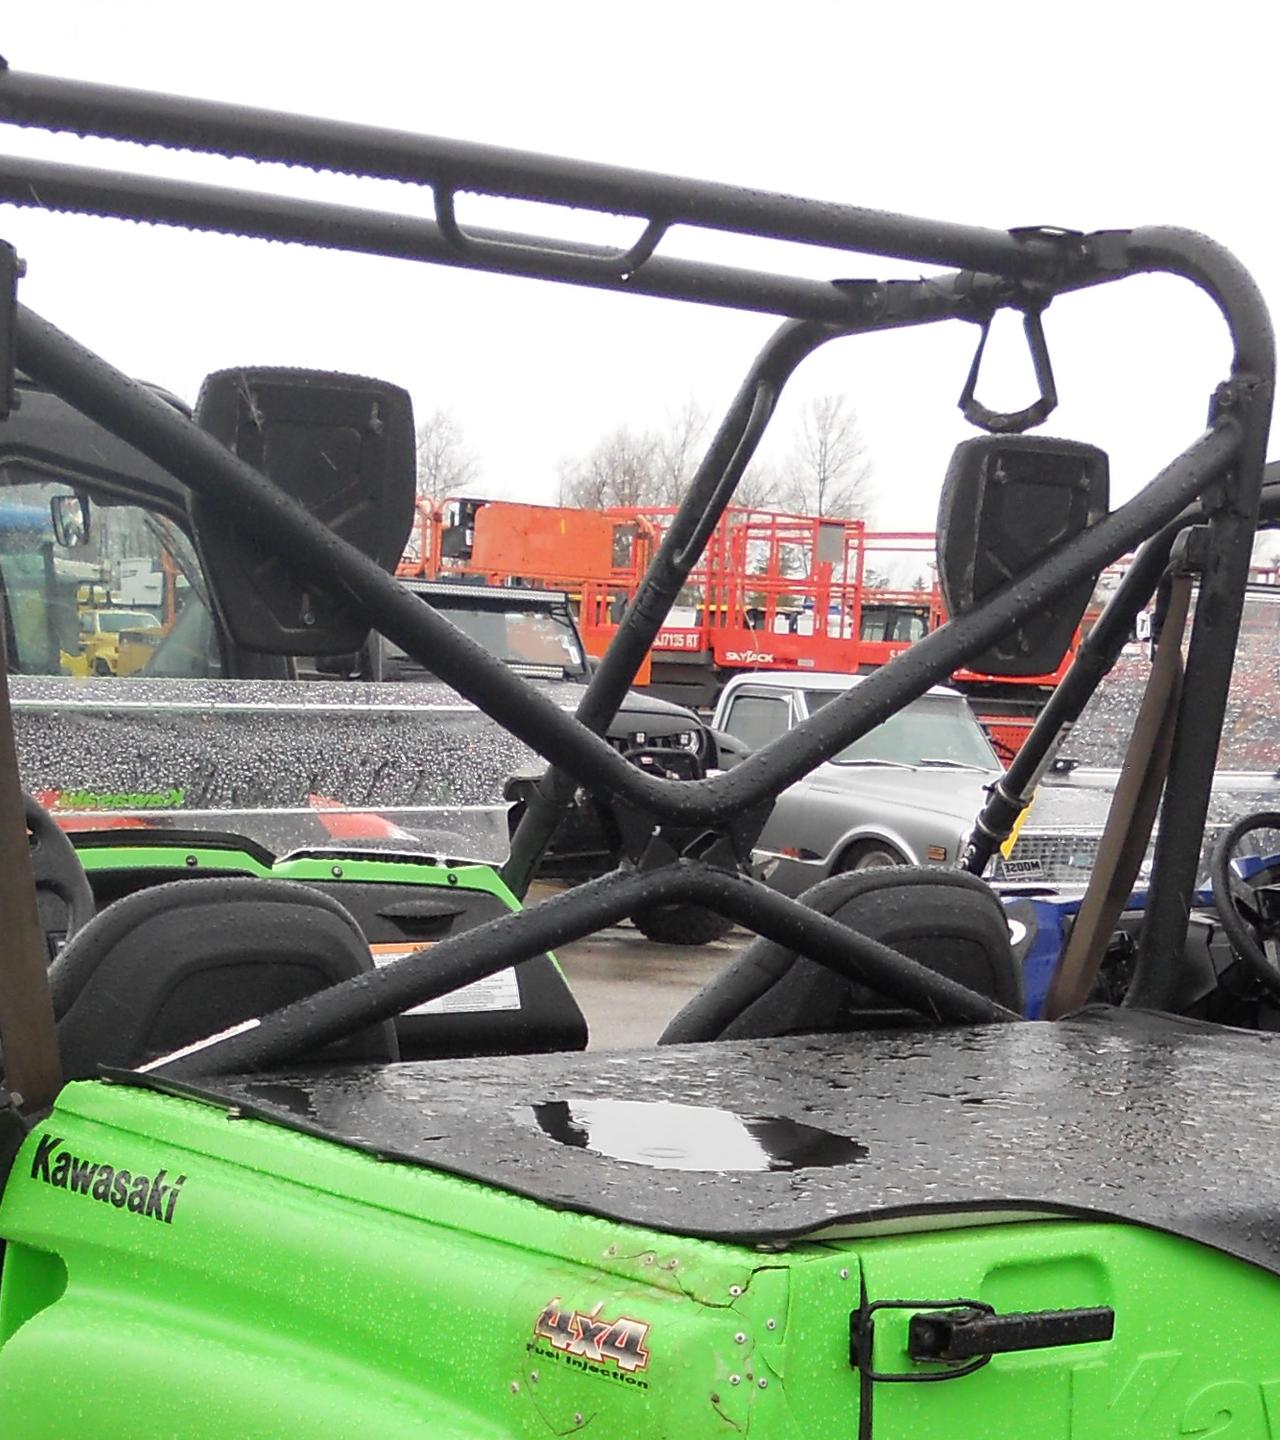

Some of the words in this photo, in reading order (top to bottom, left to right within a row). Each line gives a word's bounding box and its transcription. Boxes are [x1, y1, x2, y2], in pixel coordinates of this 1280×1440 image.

[686, 633, 699, 648] RT
[30, 1133, 188, 1225] Kawasaki
[526, 1343, 560, 1361] Fuel
[565, 1353, 649, 1390] Injection
